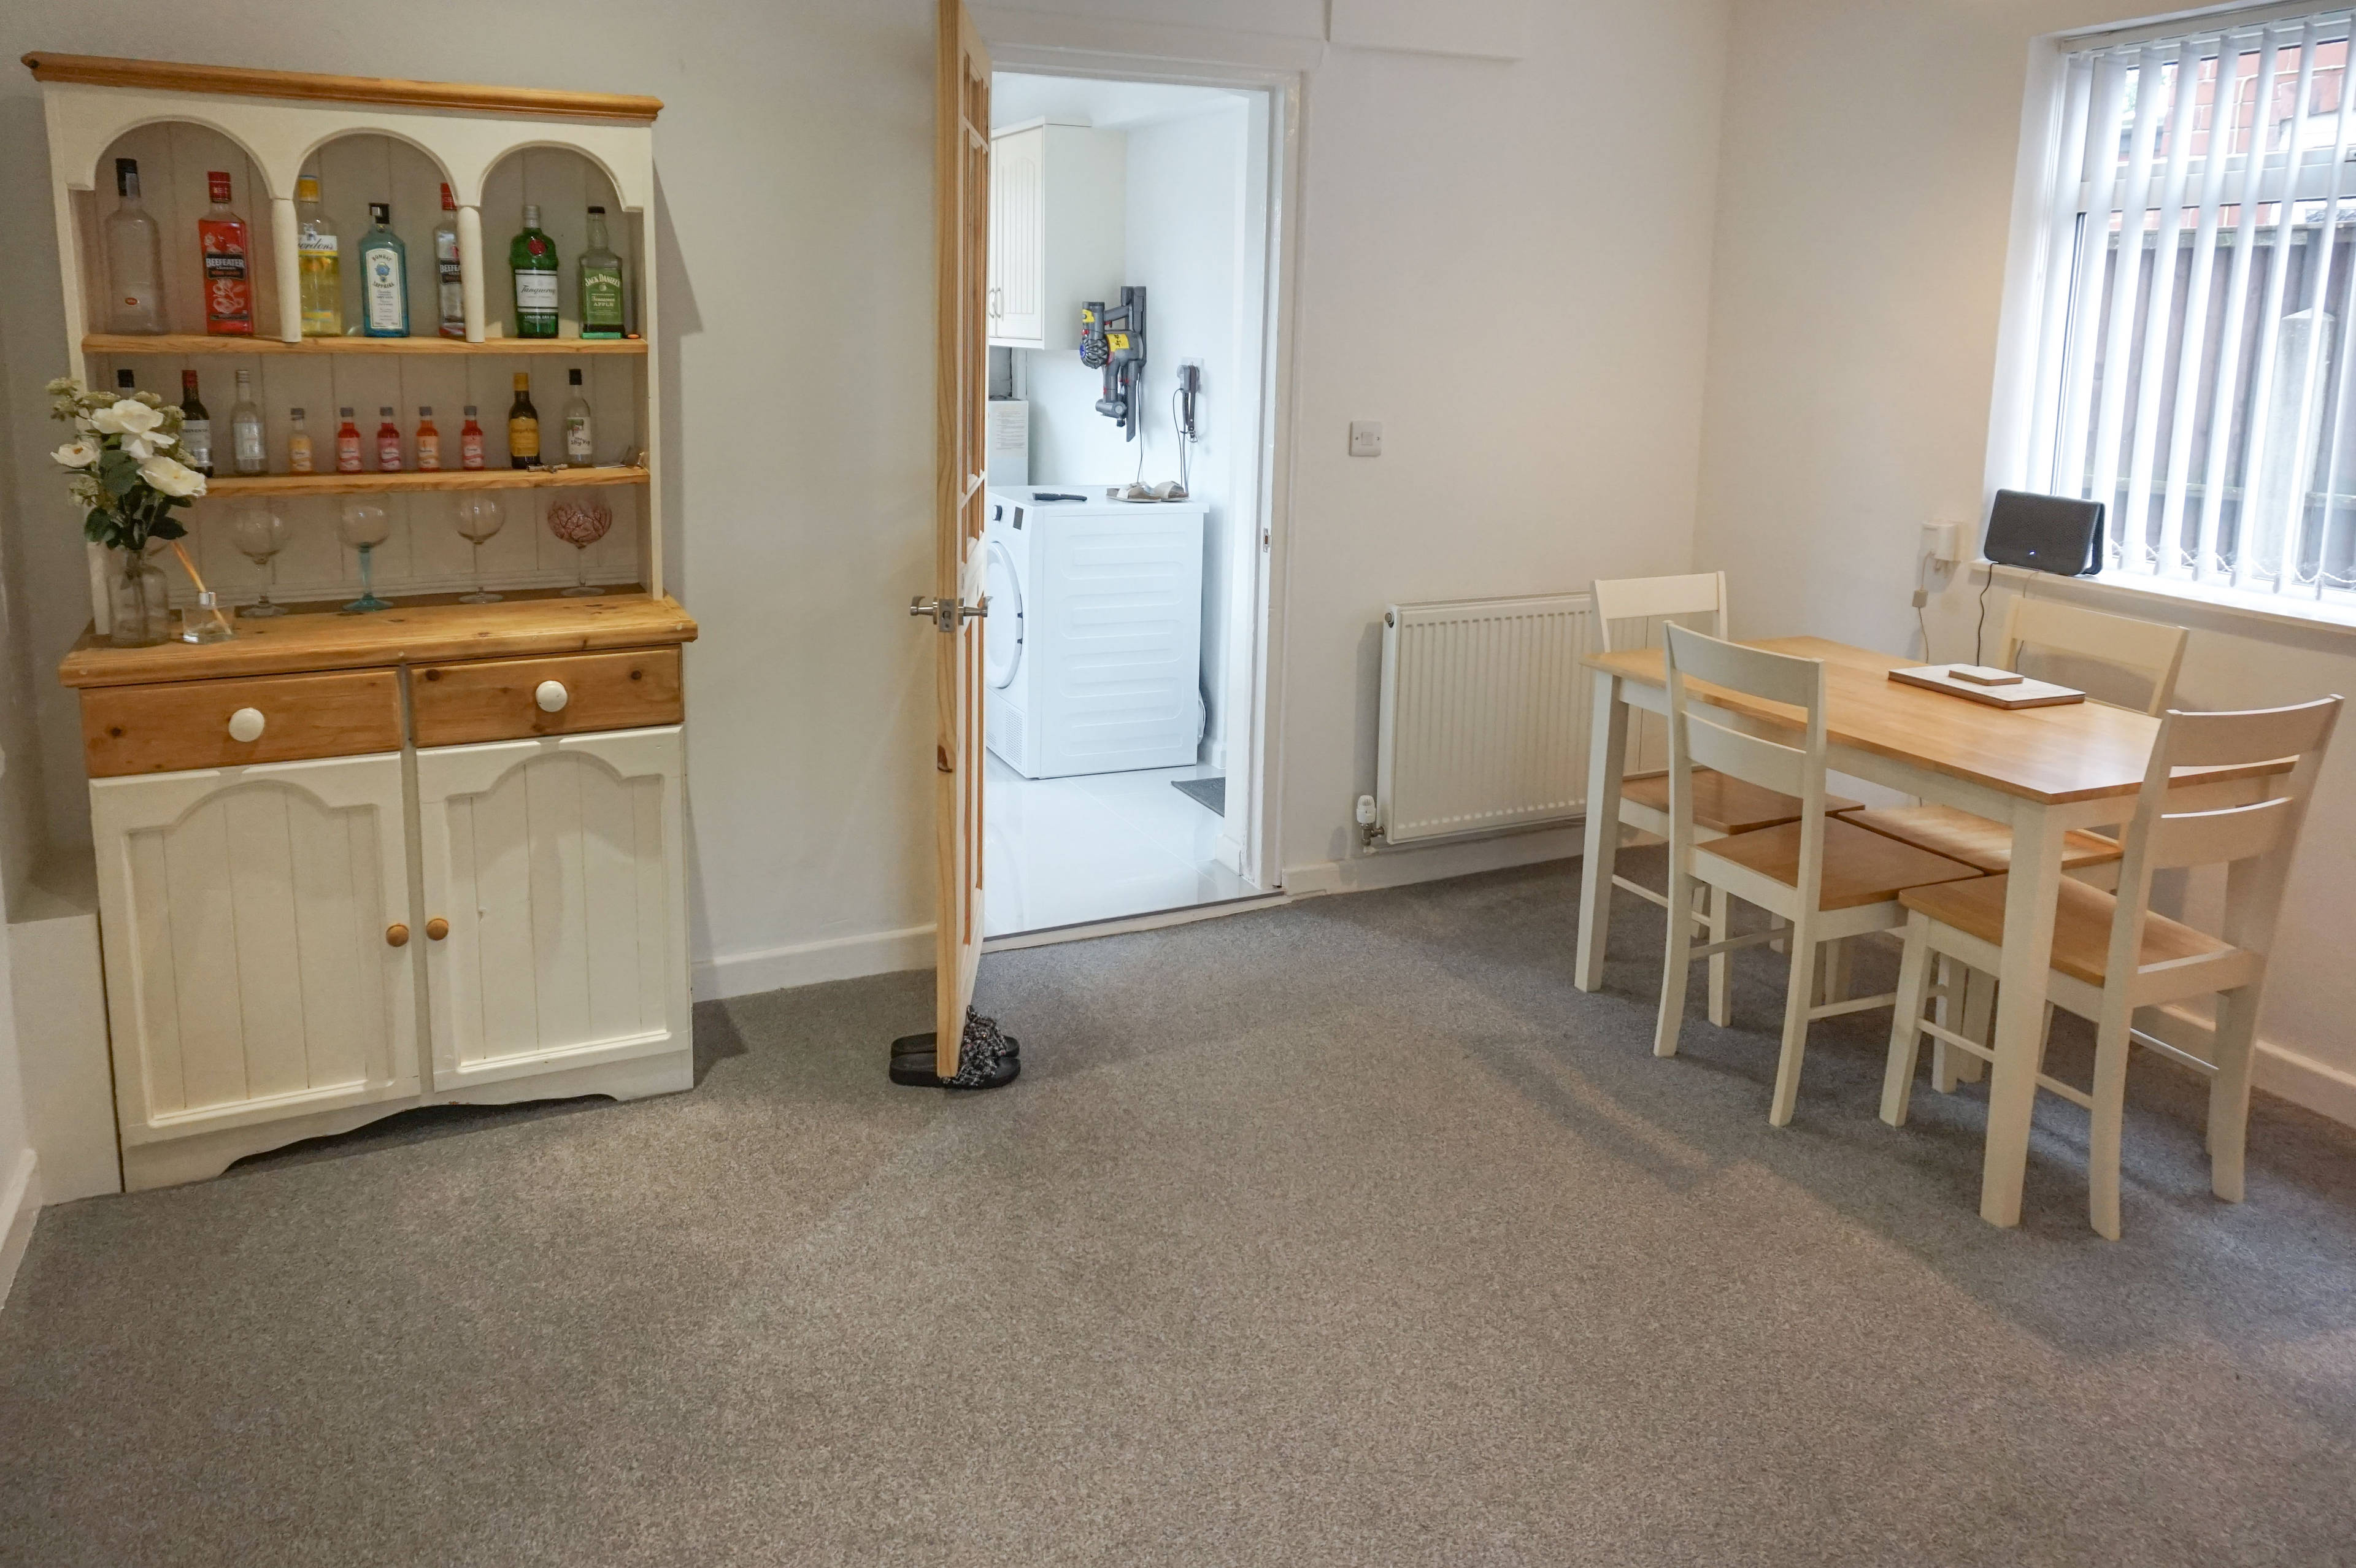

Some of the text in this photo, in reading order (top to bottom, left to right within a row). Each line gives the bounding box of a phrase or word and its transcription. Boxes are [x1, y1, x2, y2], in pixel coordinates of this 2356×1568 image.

[206, 258, 245, 268] BEEFEATER
[439, 264, 461, 273] BEEFEA
[585, 276, 599, 286] JACK
